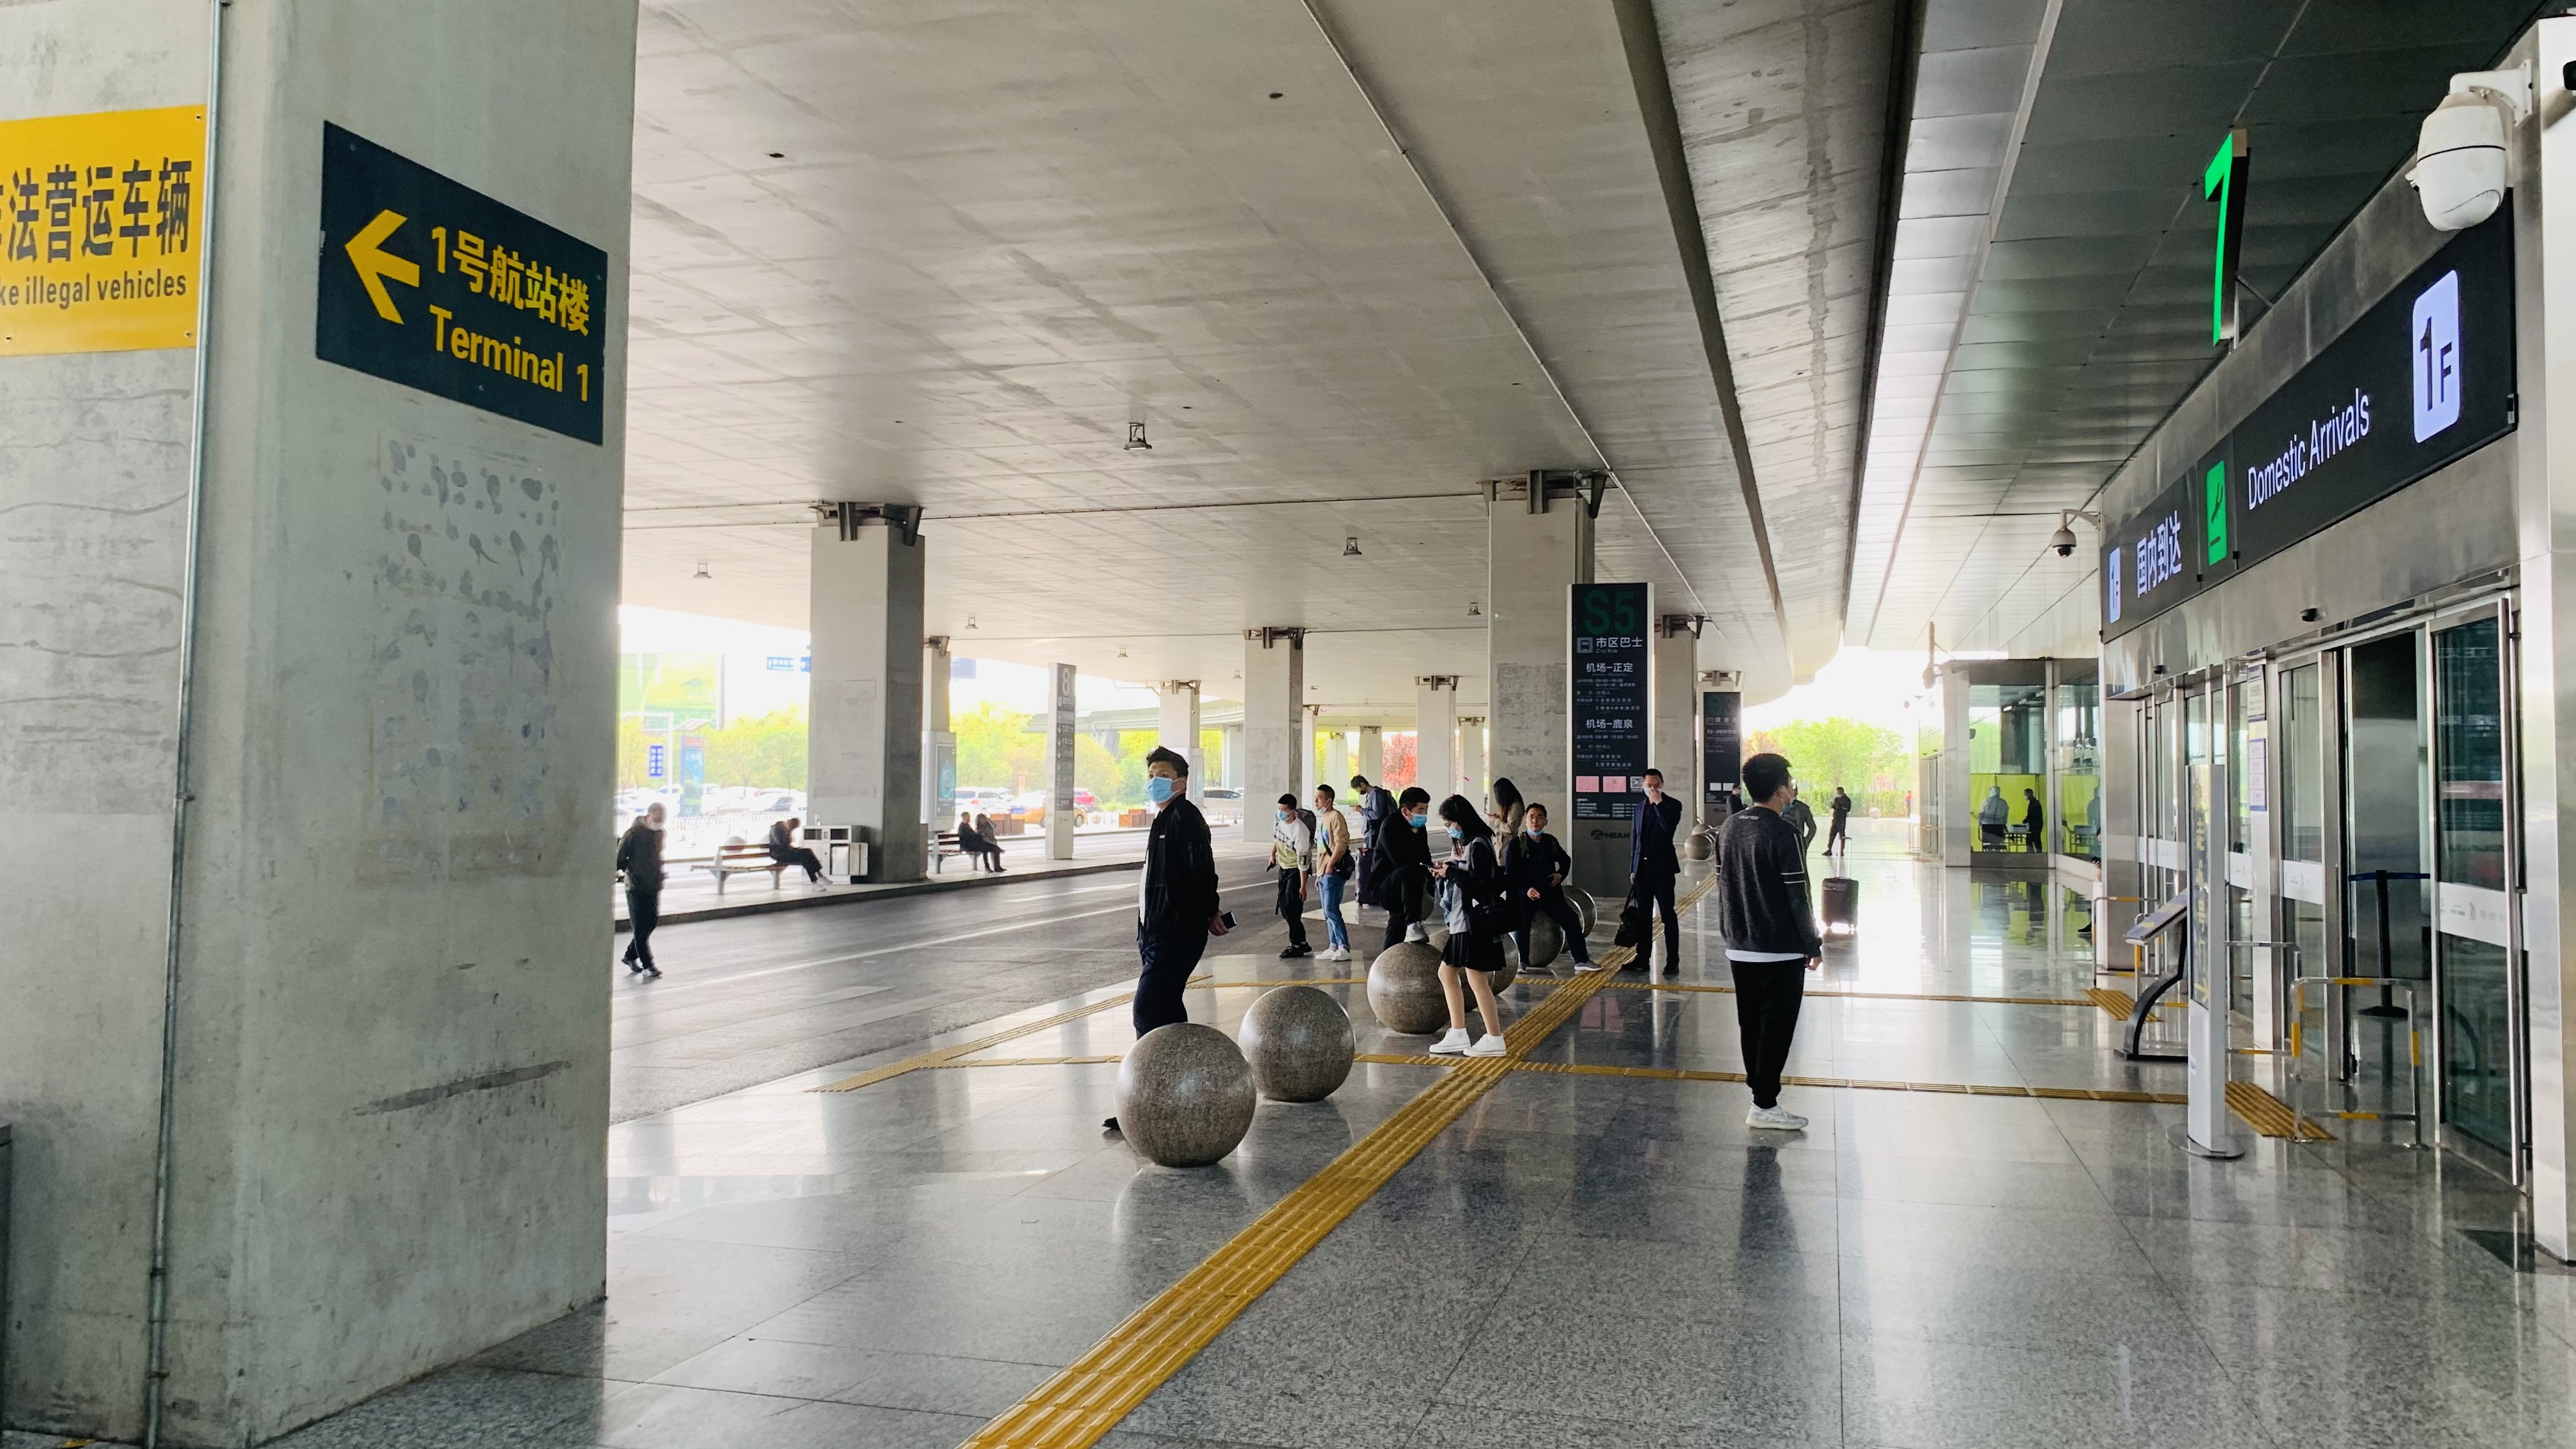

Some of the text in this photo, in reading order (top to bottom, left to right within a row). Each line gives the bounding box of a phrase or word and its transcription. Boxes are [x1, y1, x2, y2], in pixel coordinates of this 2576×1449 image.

[0, 157, 192, 263] 法营运车辆
[2205, 132, 2233, 346] 1
[26, 271, 90, 310] illegal
[96, 268, 187, 301] vehicles
[430, 226, 590, 337] 1号航站楼
[429, 305, 588, 402] Terminal 1
[2419, 316, 2453, 412] 1F
[2248, 388, 2371, 511] Domestic Arrivals
[2136, 510, 2182, 599] 国内到达
[1583, 590, 1636, 635] S5
[1596, 637, 1643, 648] 市区巴士
[1062, 668, 1070, 696] 8
